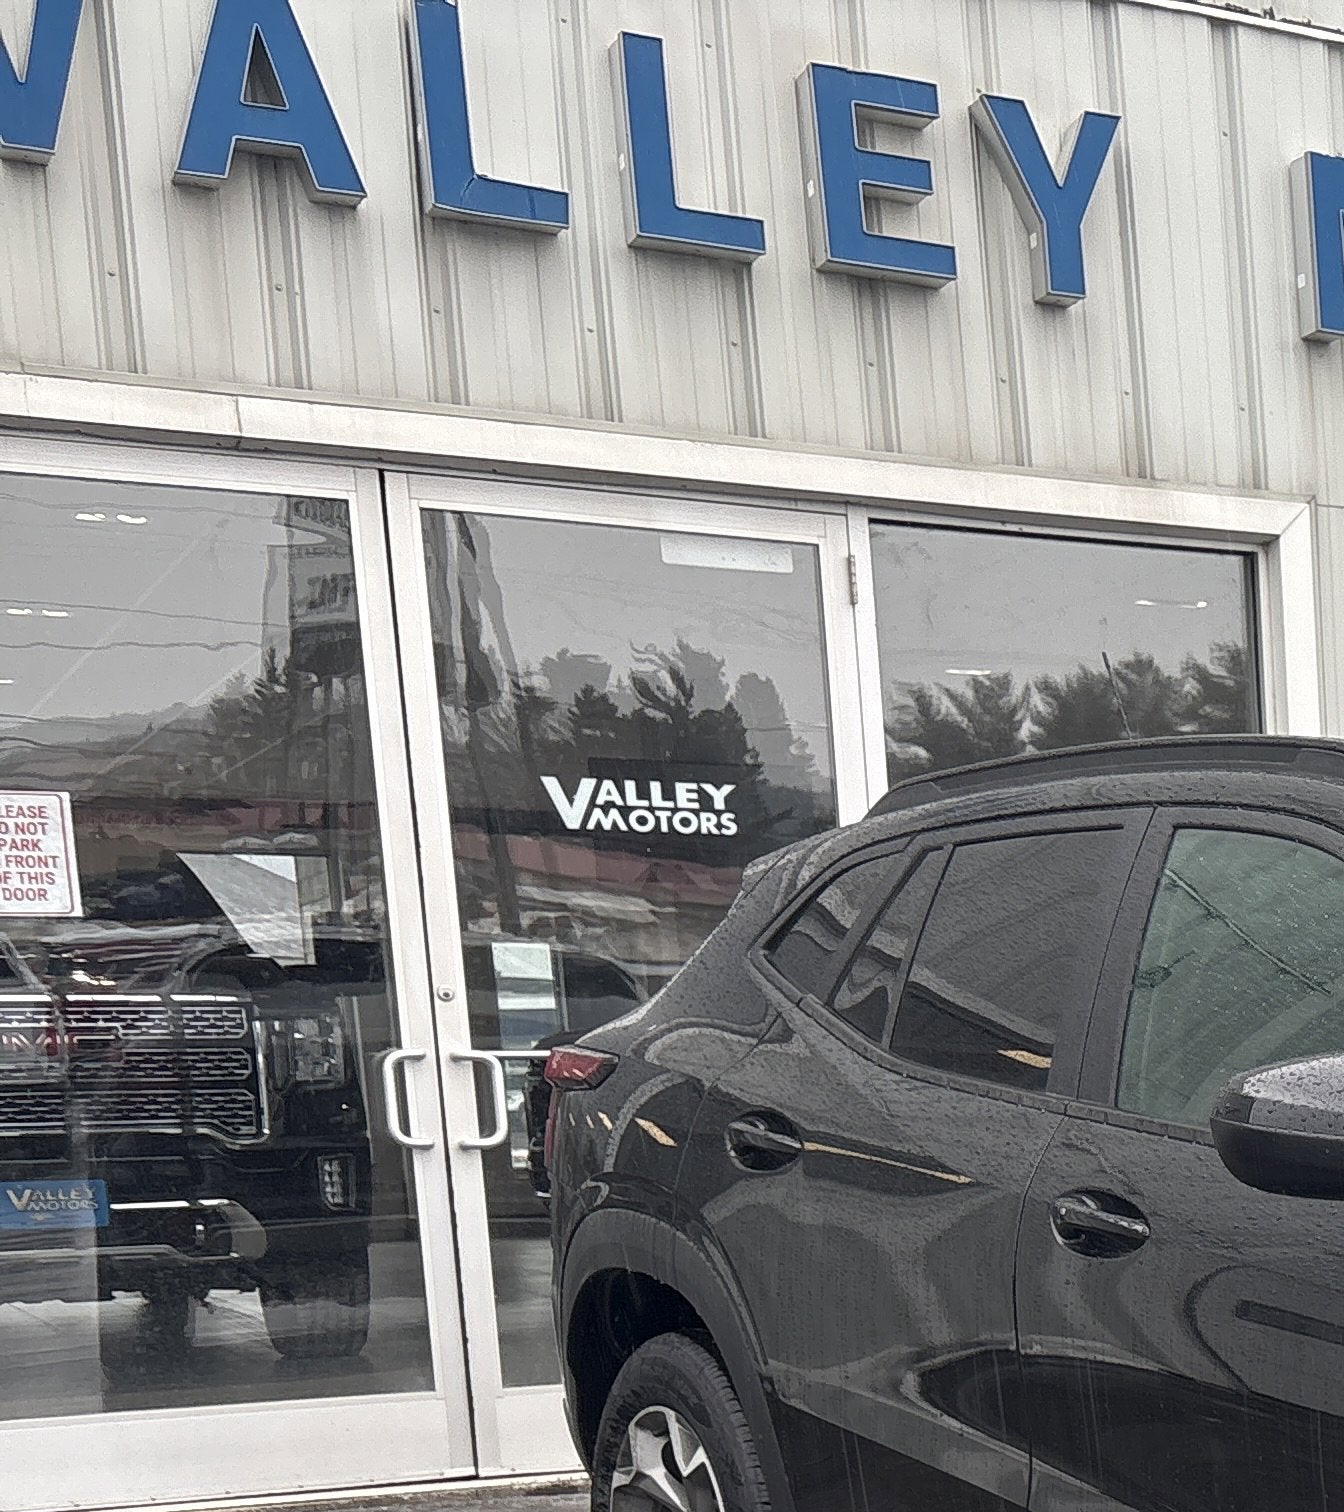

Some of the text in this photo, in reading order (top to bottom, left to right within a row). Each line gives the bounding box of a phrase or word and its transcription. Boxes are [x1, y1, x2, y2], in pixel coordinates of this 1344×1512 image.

[539, 776, 737, 830] VALLEY
[0, 804, 49, 819] EASE
[14, 822, 49, 835] NOT
[585, 807, 738, 836] MOTORS
[4, 854, 60, 869] FRONT
[16, 871, 56, 886] THIS
[2, 887, 49, 901] DOOR
[6, 1184, 95, 1211] VALLEY
[27, 1200, 99, 1211] MOTORS
